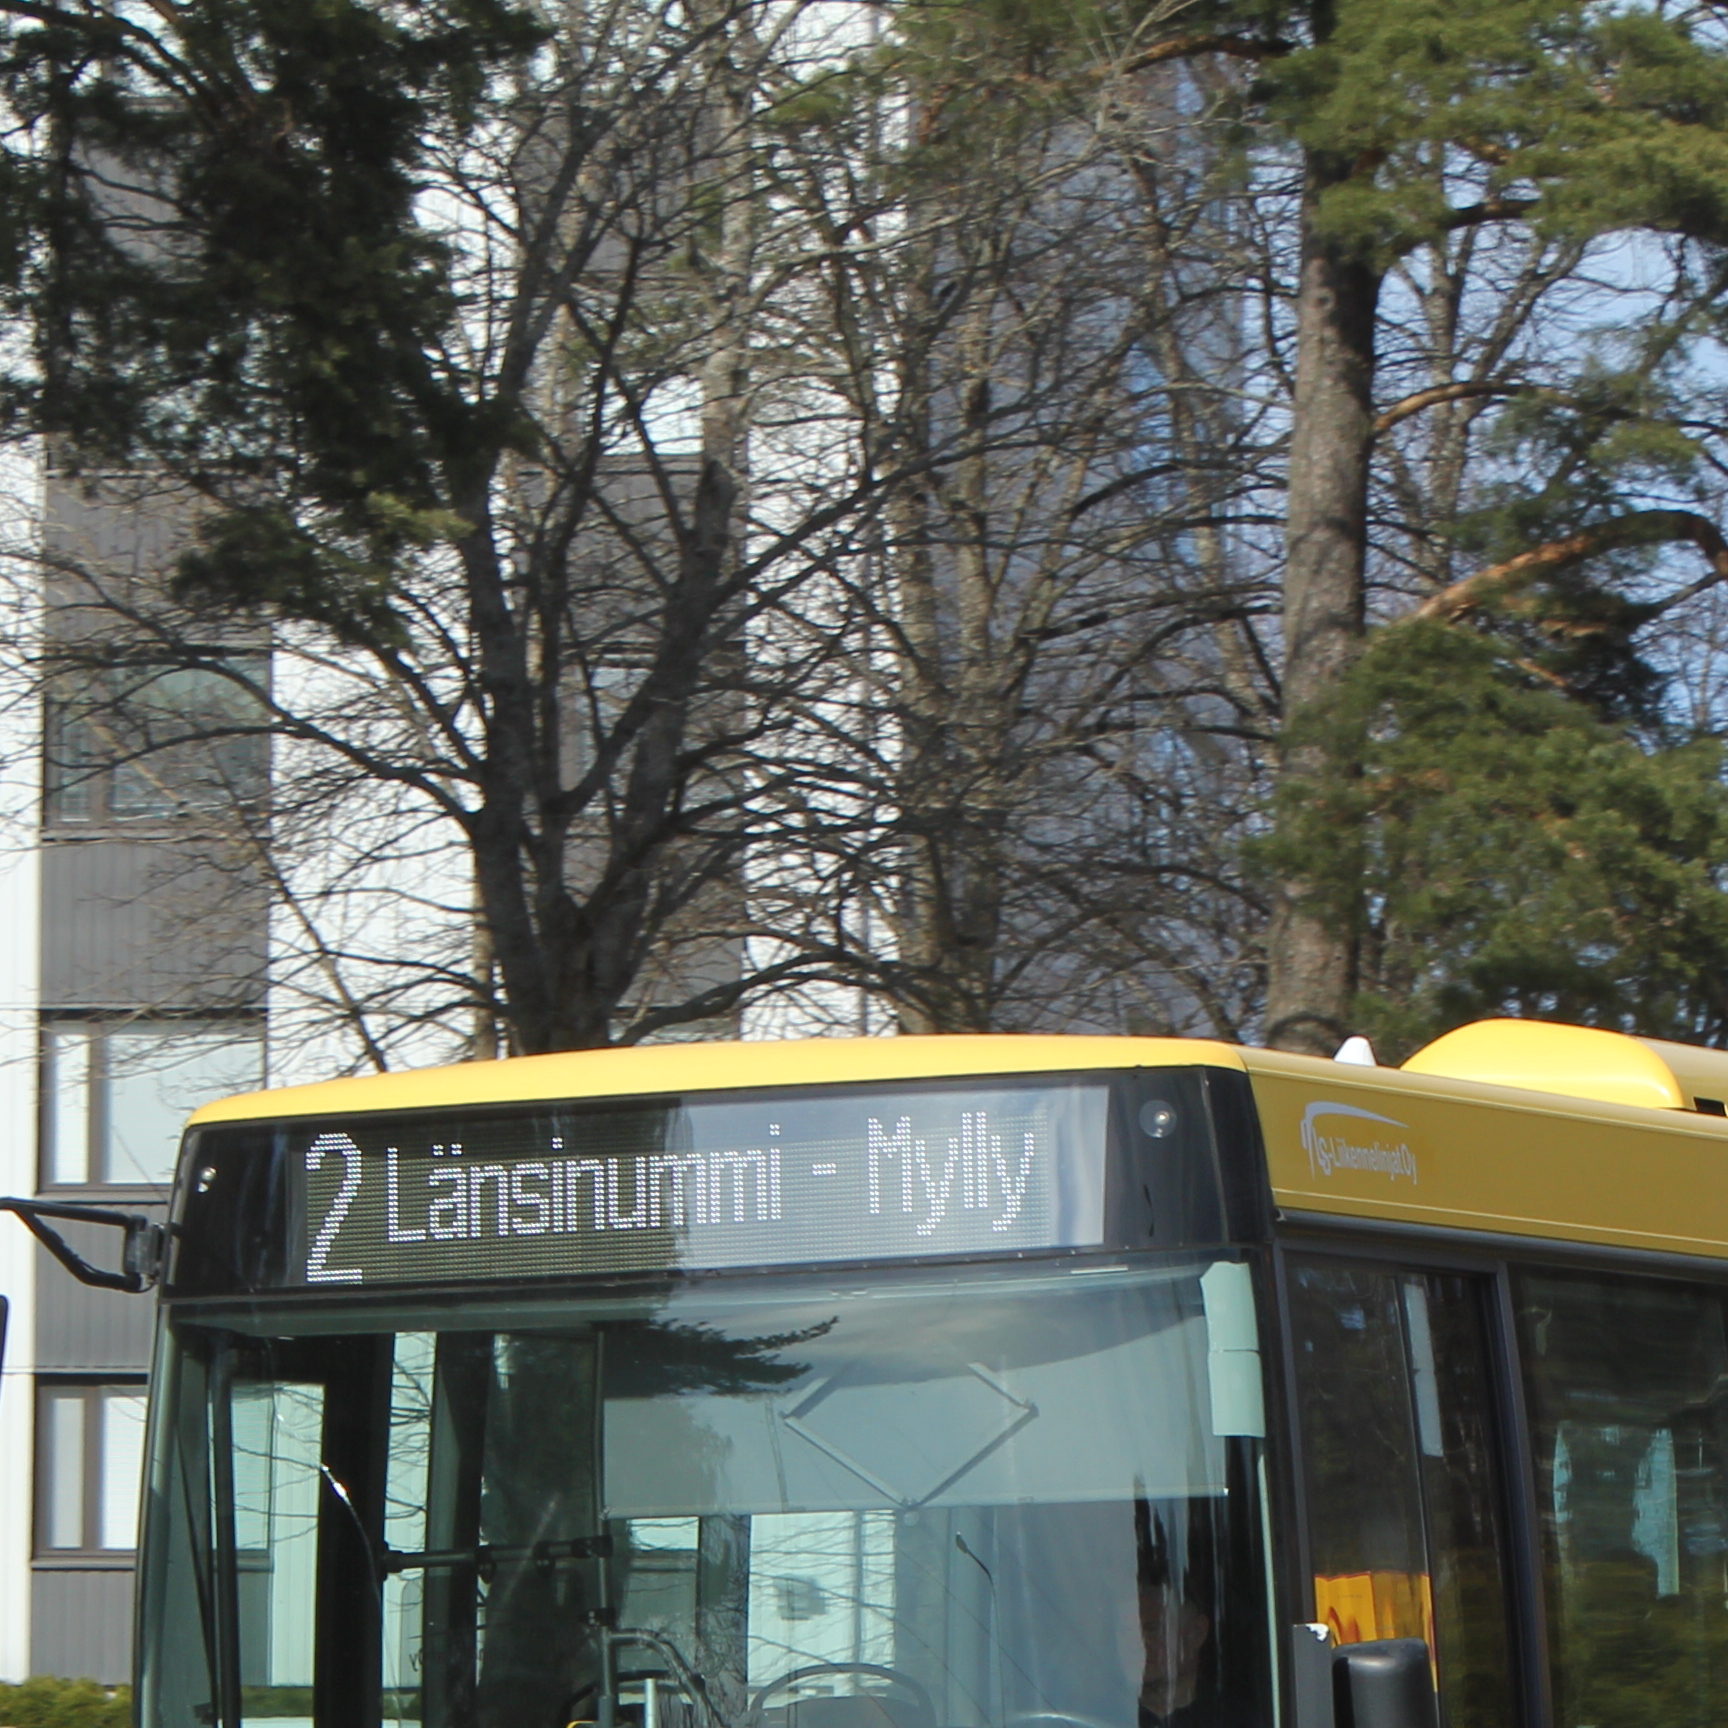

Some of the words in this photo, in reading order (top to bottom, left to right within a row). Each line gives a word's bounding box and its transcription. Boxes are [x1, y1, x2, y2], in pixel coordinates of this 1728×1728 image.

[305, 1131, 363, 1285] 2
[387, 1123, 782, 1242] Länsinummi
[867, 1111, 1035, 1237] Mylly
